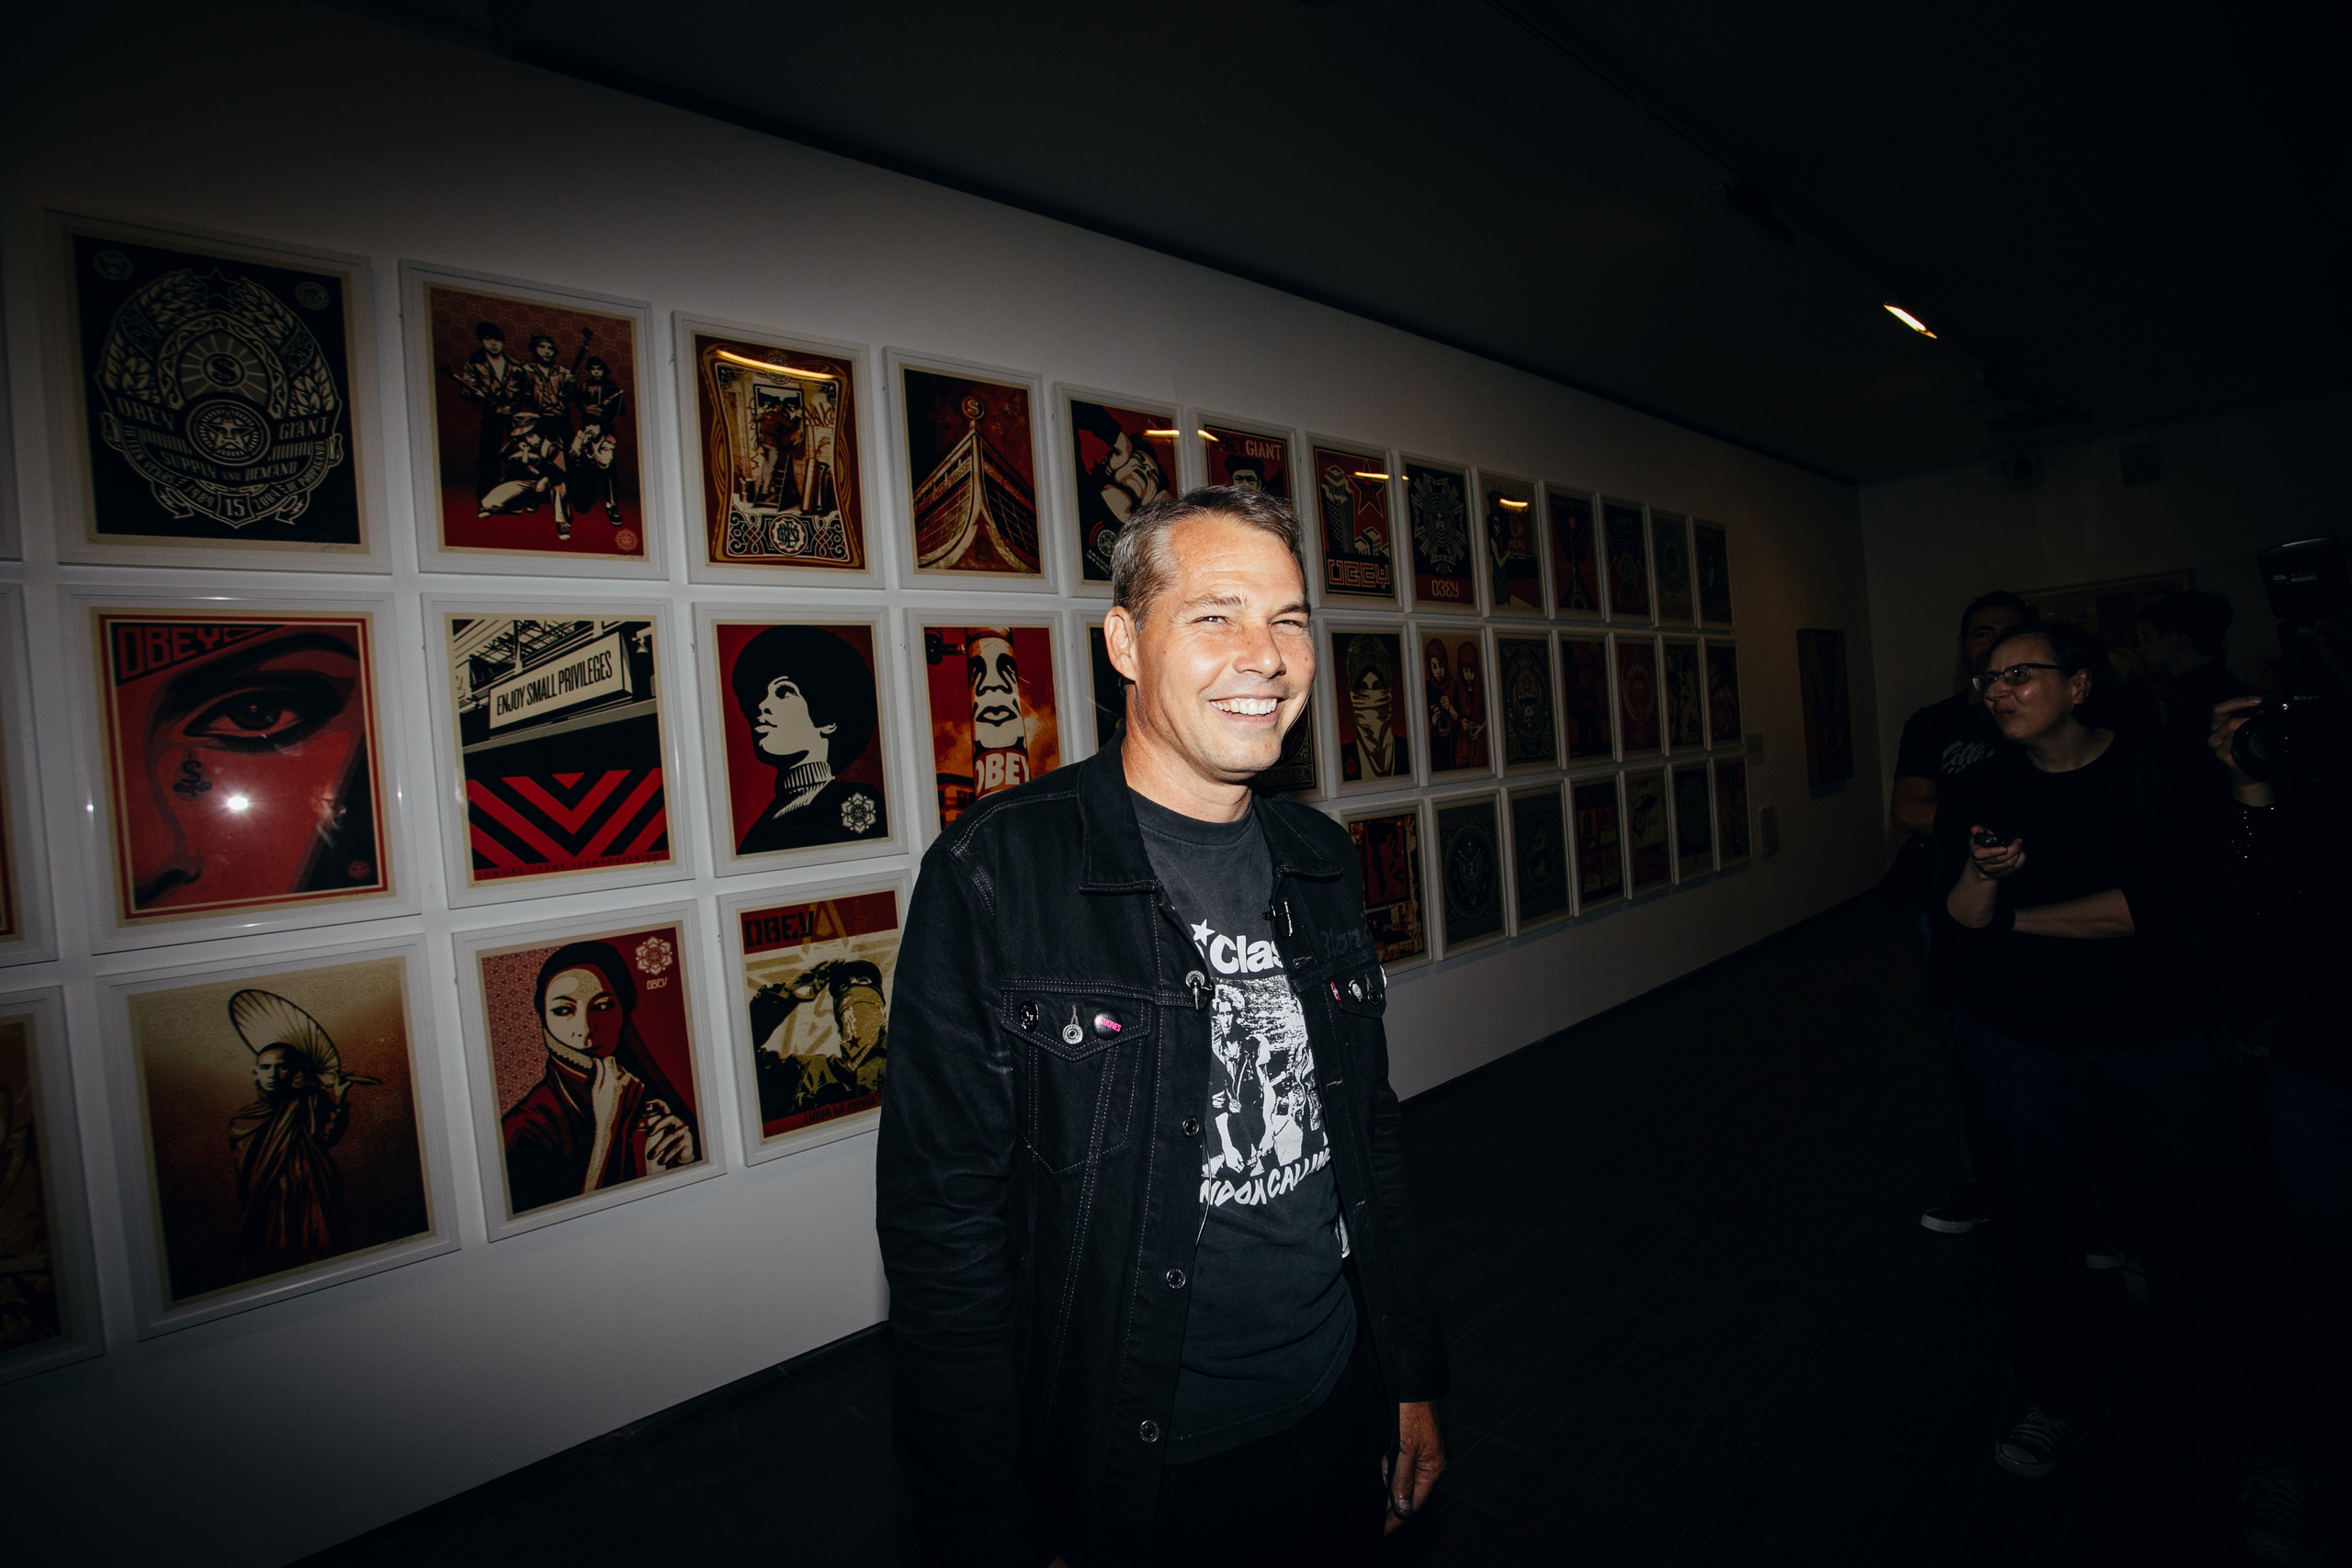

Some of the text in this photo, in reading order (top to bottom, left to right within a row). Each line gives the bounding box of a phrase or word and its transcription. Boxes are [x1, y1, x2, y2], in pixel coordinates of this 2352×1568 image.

[116, 396, 176, 431] OBEY
[278, 416, 331, 440] GIANT
[1245, 438, 1283, 461] GIANT
[142, 459, 176, 485] YEARS
[159, 450, 219, 479] SUPPLY
[244, 460, 299, 482] DEMAND
[184, 483, 216, 508] 1989
[225, 498, 245, 517] 15
[118, 626, 221, 680] OBEY
[496, 649, 613, 716] ENJOY SMALL PRIVILEGES
[2292, 694, 2319, 702] Nikon
[743, 910, 815, 948] OBEY
[646, 976, 669, 990] OBEY
